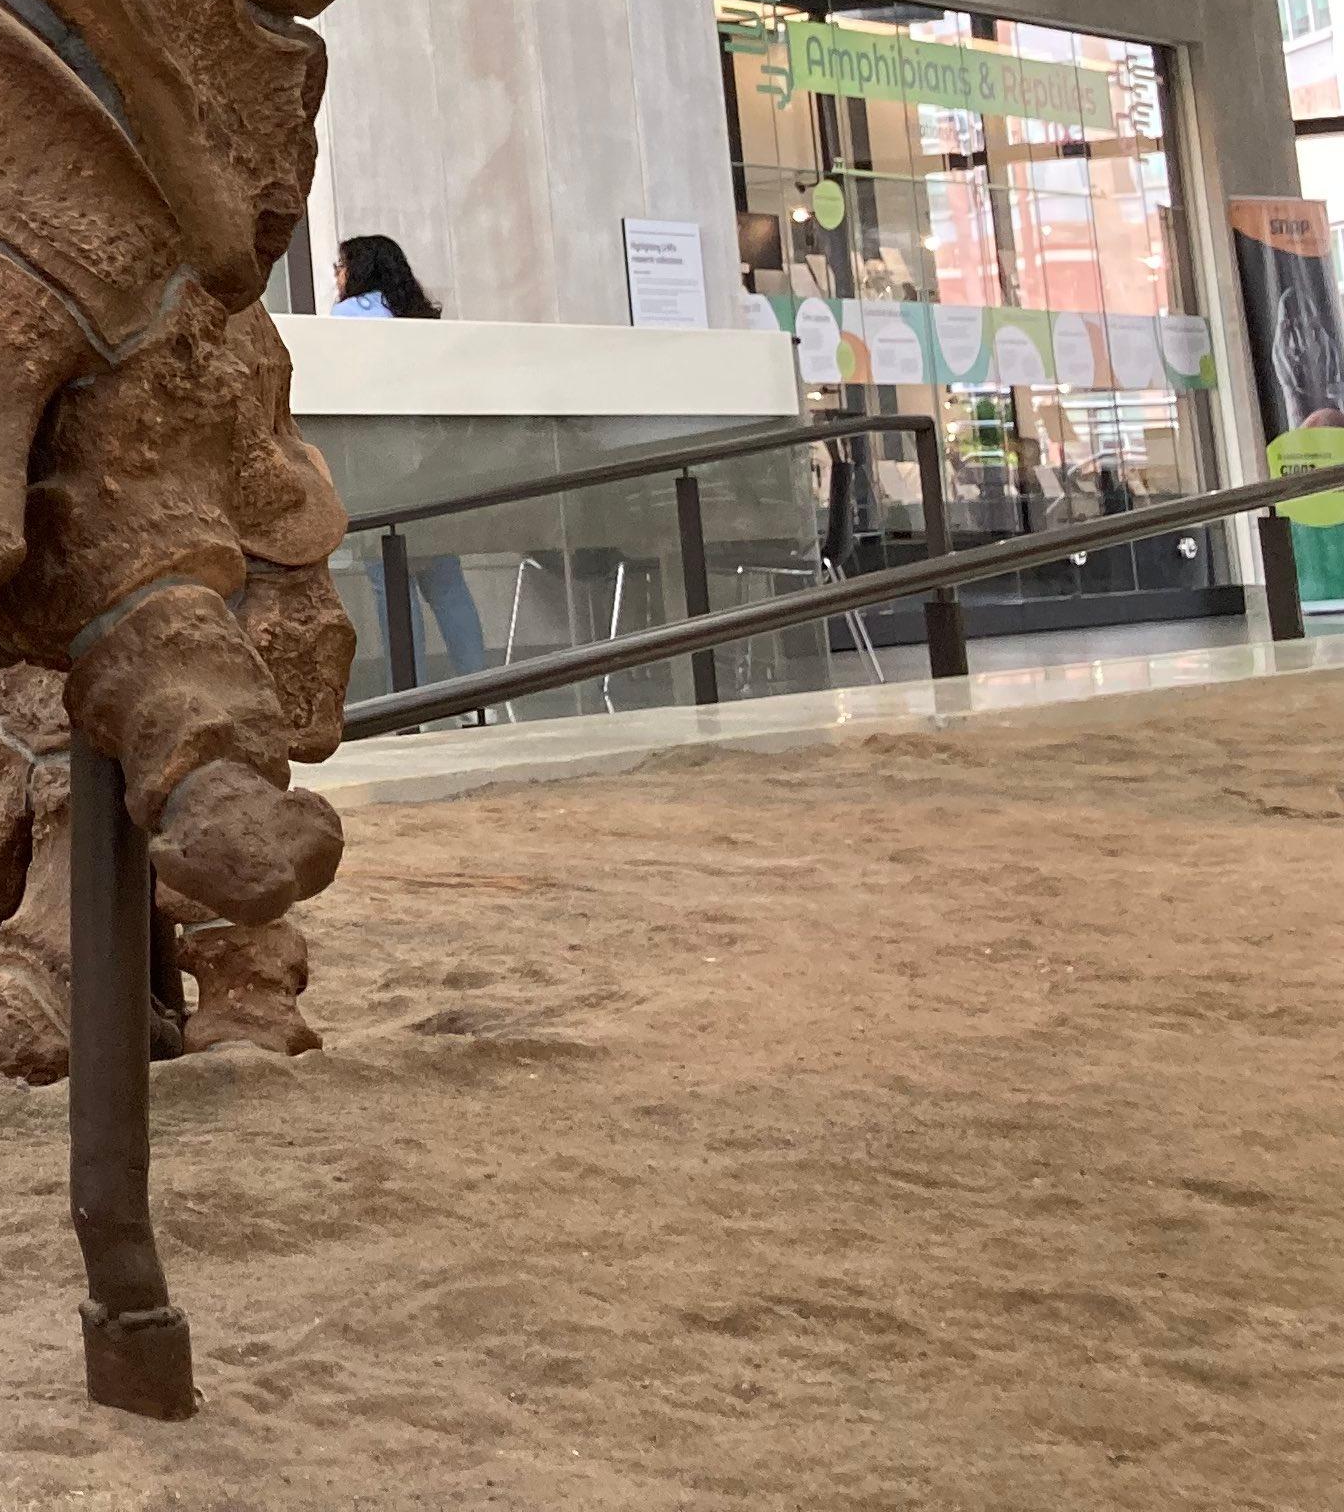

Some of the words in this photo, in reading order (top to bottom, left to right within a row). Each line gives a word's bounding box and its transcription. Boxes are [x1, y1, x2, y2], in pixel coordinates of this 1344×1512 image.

[805, 34, 972, 96] Amphibians
[978, 61, 996, 100] &
[1000, 64, 1097, 116] Reptiles
